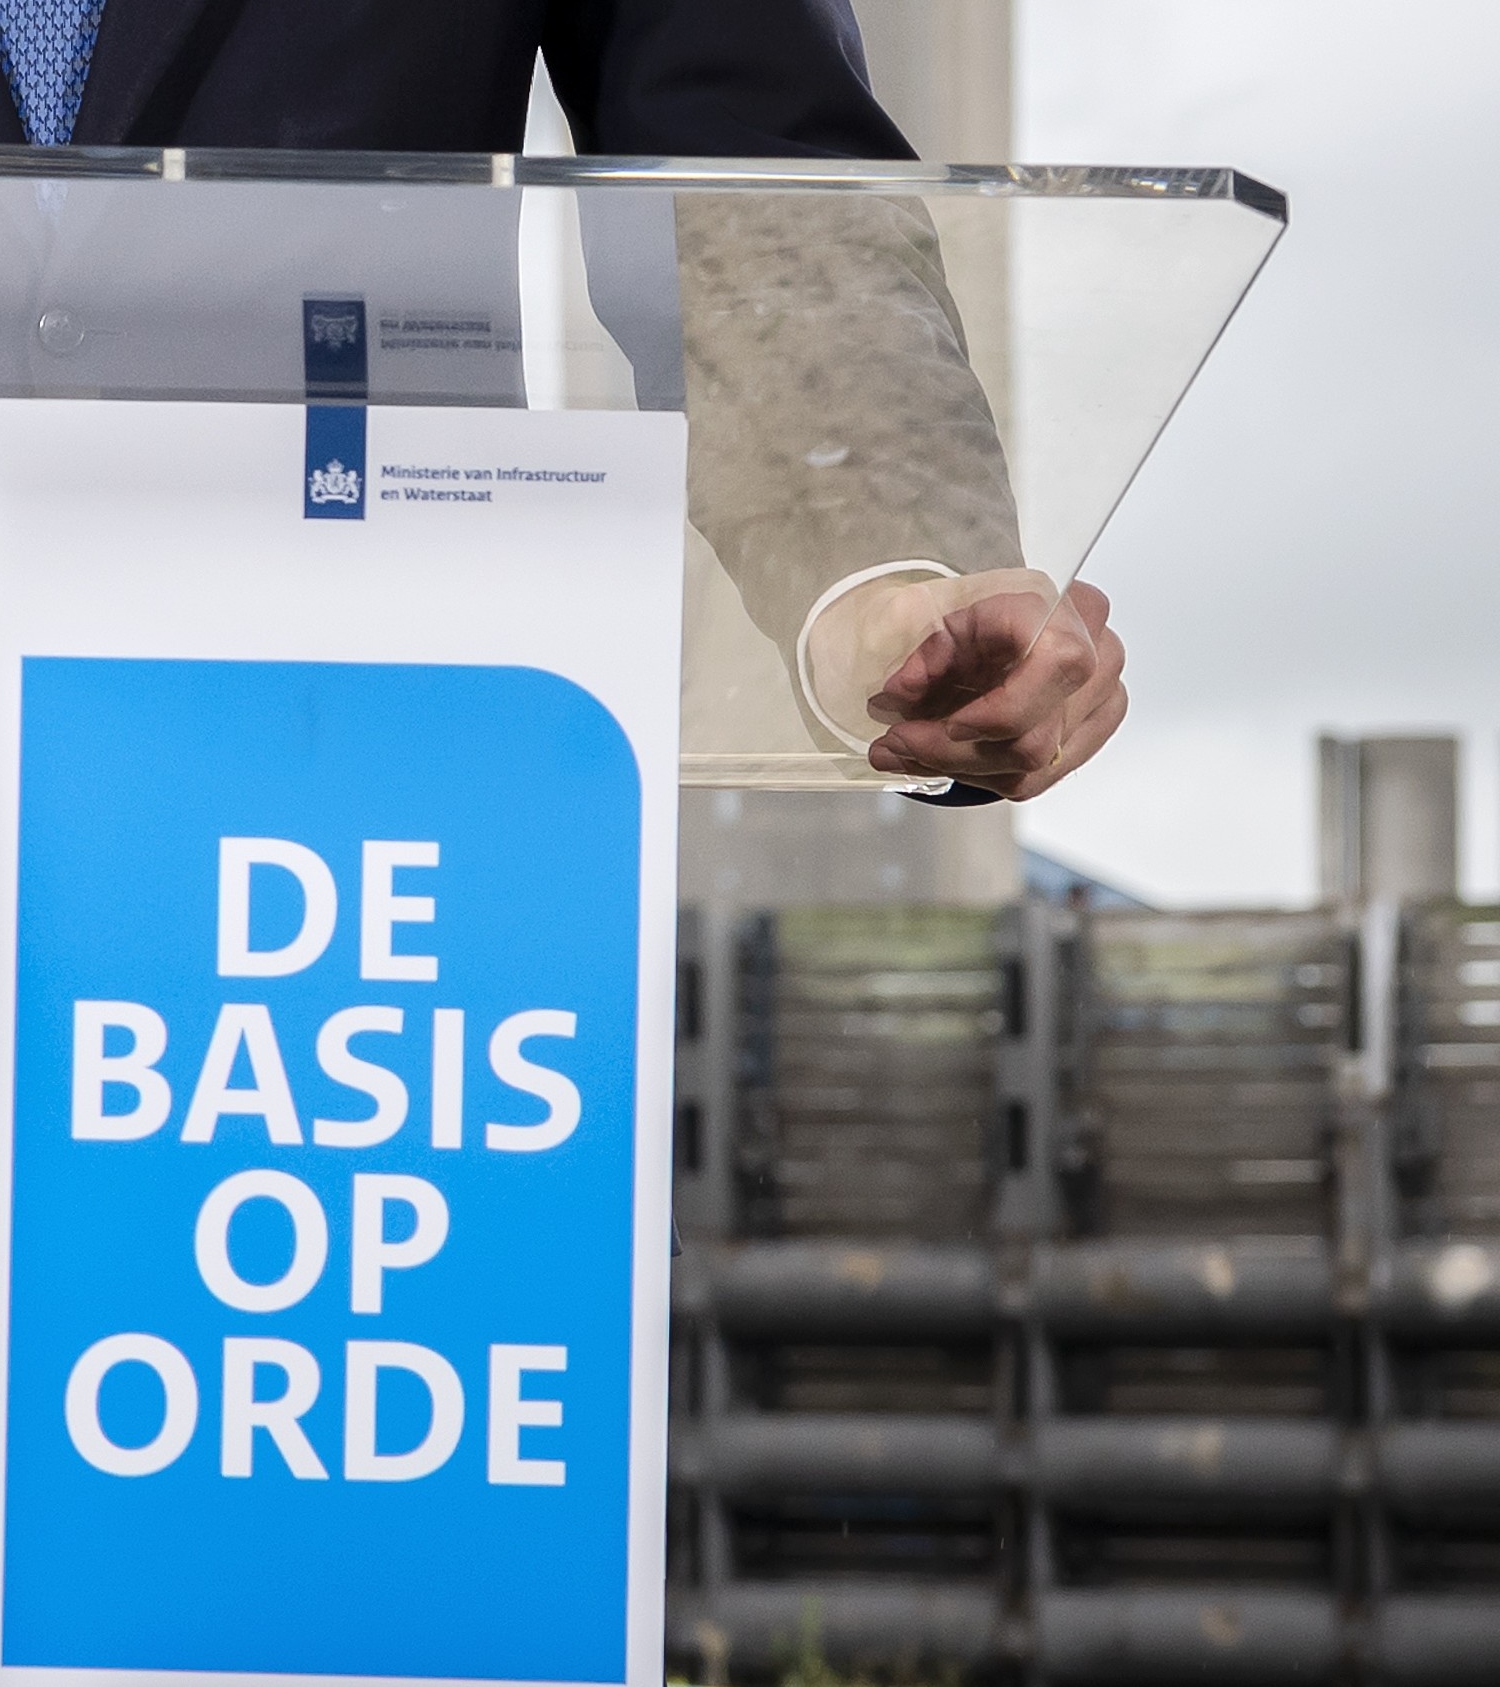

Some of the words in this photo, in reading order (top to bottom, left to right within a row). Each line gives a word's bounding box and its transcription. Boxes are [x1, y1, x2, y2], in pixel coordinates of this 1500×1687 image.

[381, 465, 461, 481] Ministerie
[464, 470, 493, 481] van
[497, 467, 607, 483] Infrastructuur
[381, 490, 400, 501] en
[403, 487, 493, 503] Waterstaat
[217, 836, 440, 982] DE
[71, 999, 581, 1152] BASIS
[195, 1169, 449, 1314] OP
[65, 1333, 567, 1486] ORDE
